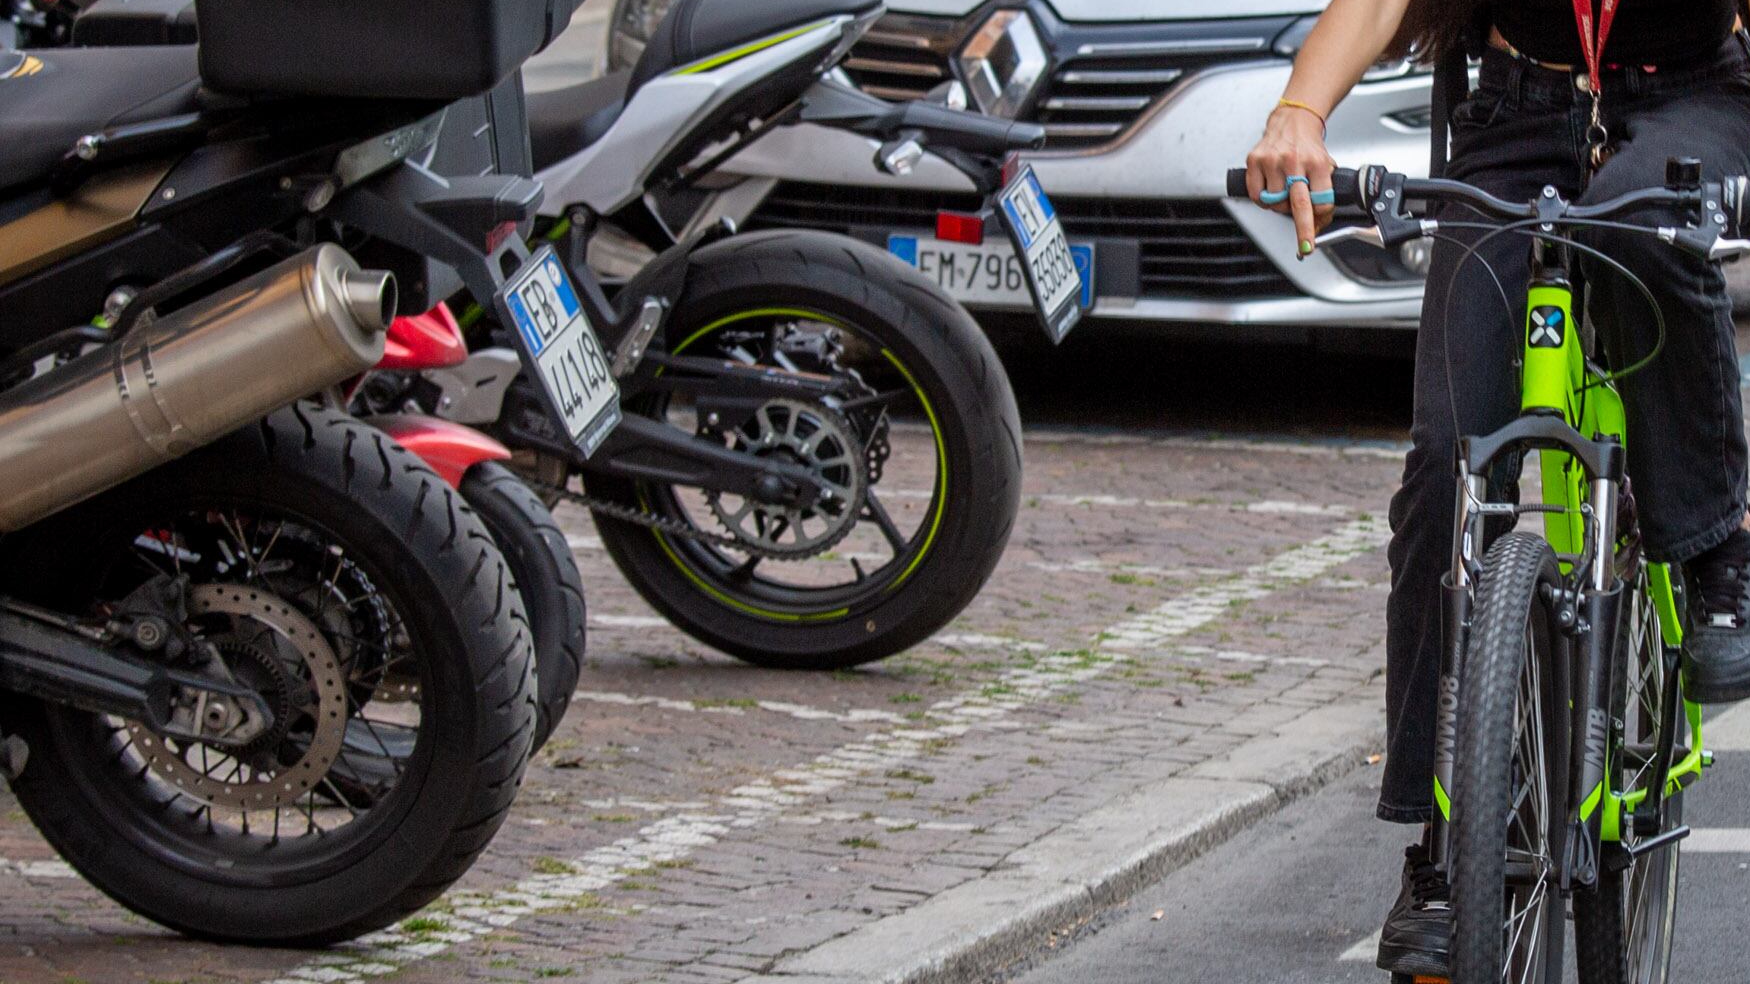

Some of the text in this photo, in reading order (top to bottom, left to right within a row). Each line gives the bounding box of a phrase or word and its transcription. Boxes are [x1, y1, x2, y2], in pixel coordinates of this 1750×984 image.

[1032, 235, 1074, 302] 35838
[521, 280, 558, 342] EB
[551, 332, 607, 420] 44148
[1584, 708, 1607, 767] MTB
